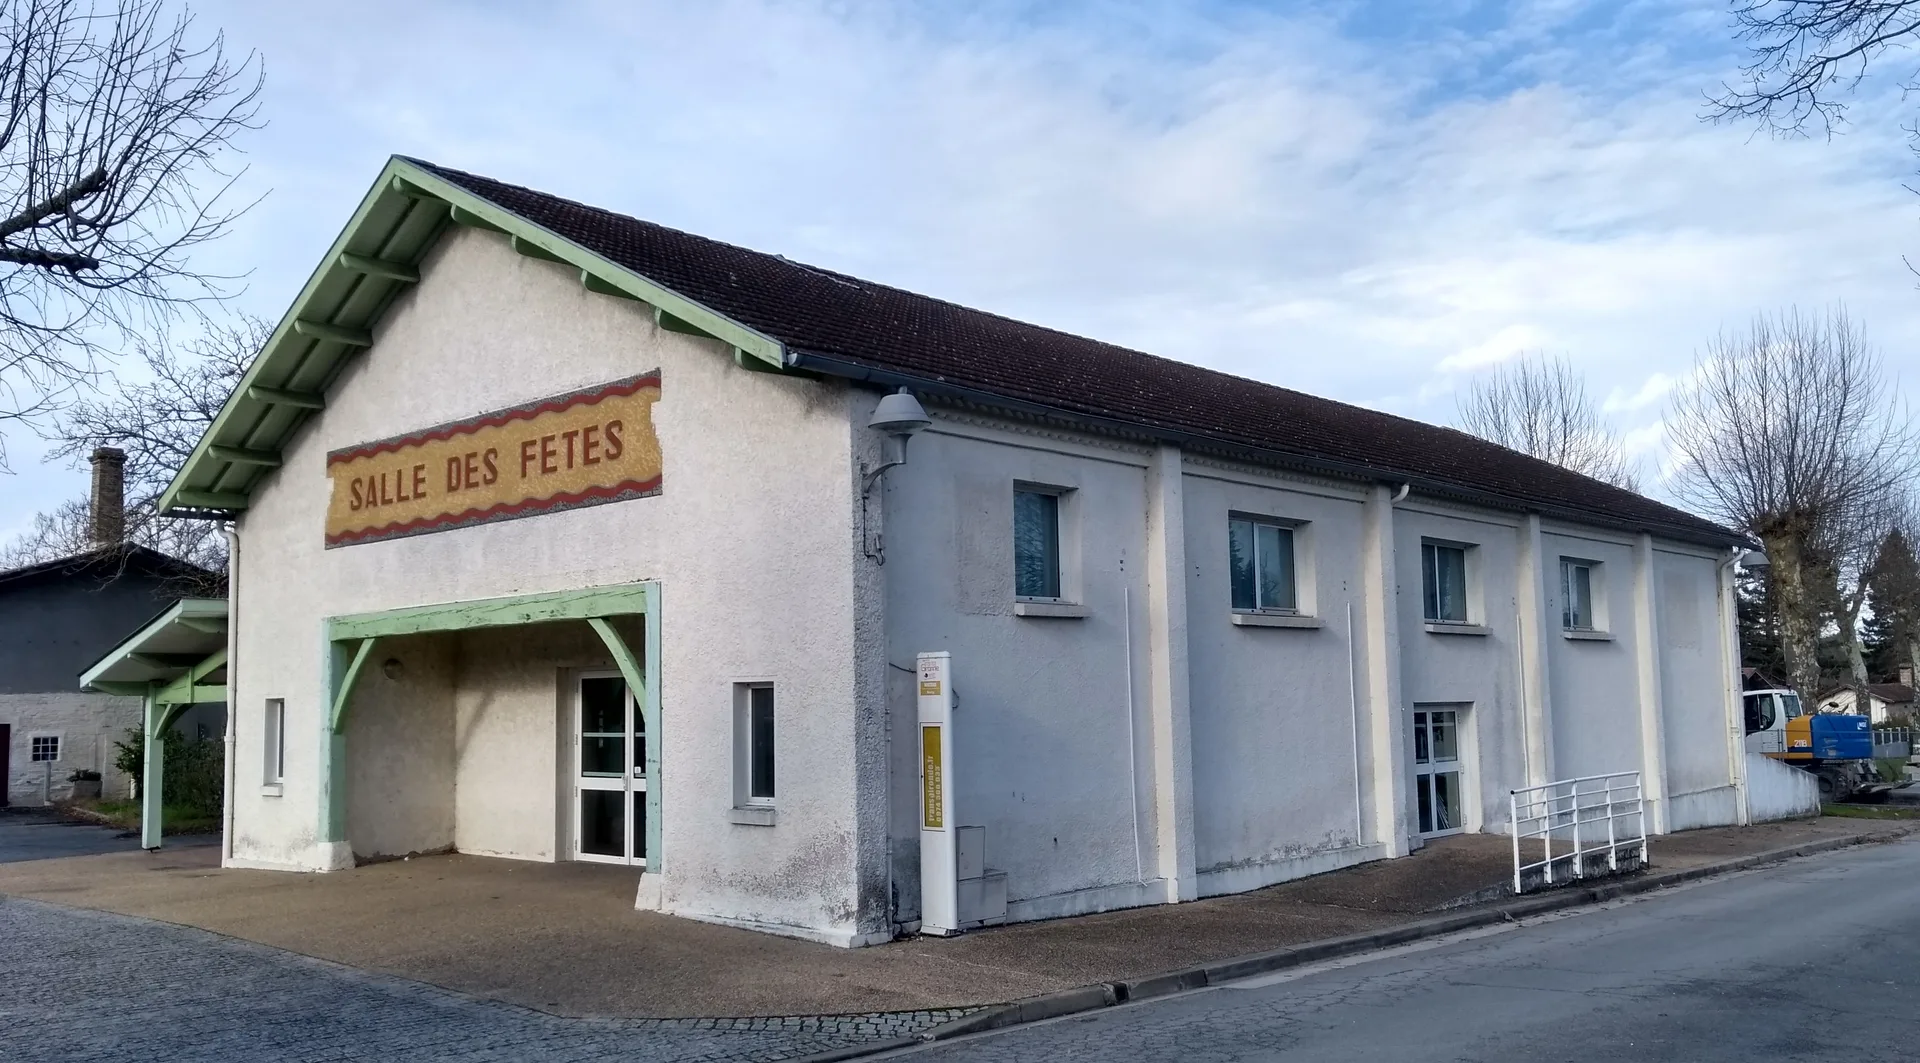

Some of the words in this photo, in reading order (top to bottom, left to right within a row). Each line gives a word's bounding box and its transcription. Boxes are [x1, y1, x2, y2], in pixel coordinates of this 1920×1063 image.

[350, 464, 427, 511] SALLE
[447, 447, 498, 493] DES
[521, 419, 623, 478] FETES
